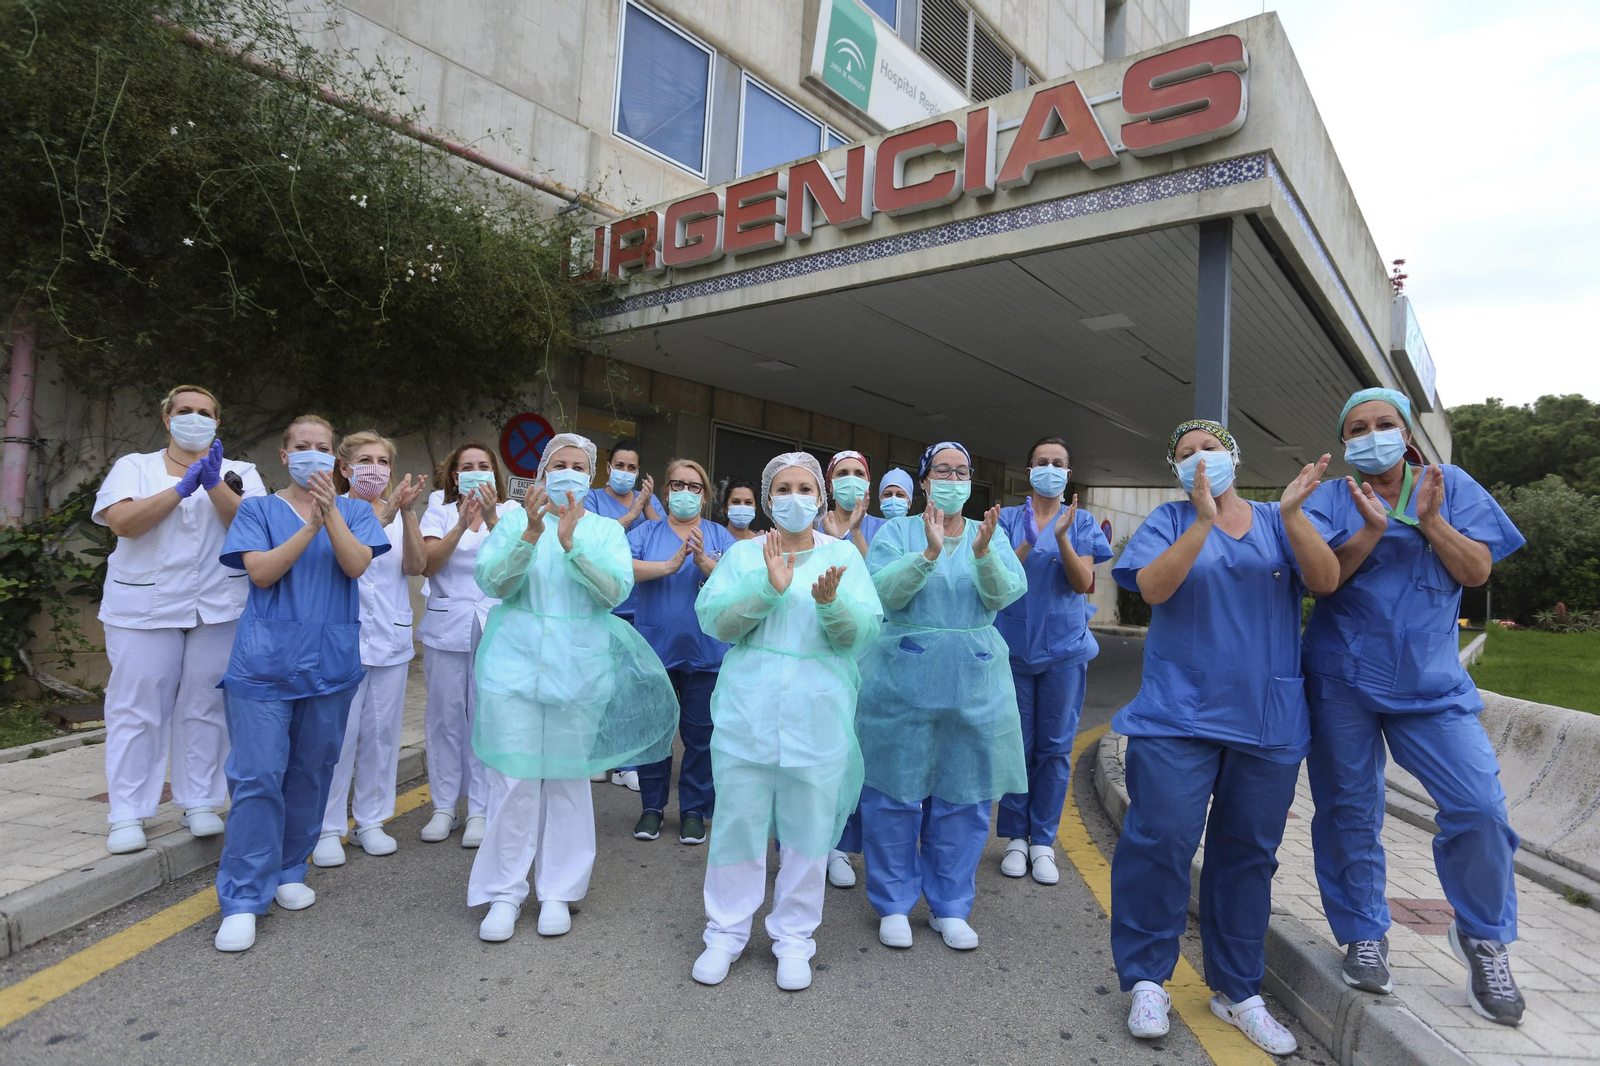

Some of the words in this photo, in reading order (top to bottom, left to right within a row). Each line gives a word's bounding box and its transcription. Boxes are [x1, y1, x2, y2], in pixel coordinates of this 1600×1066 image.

[560, 33, 1248, 290] URGENCIAS
[880, 59, 917, 100] Hospital
[919, 91, 942, 118] Regio
